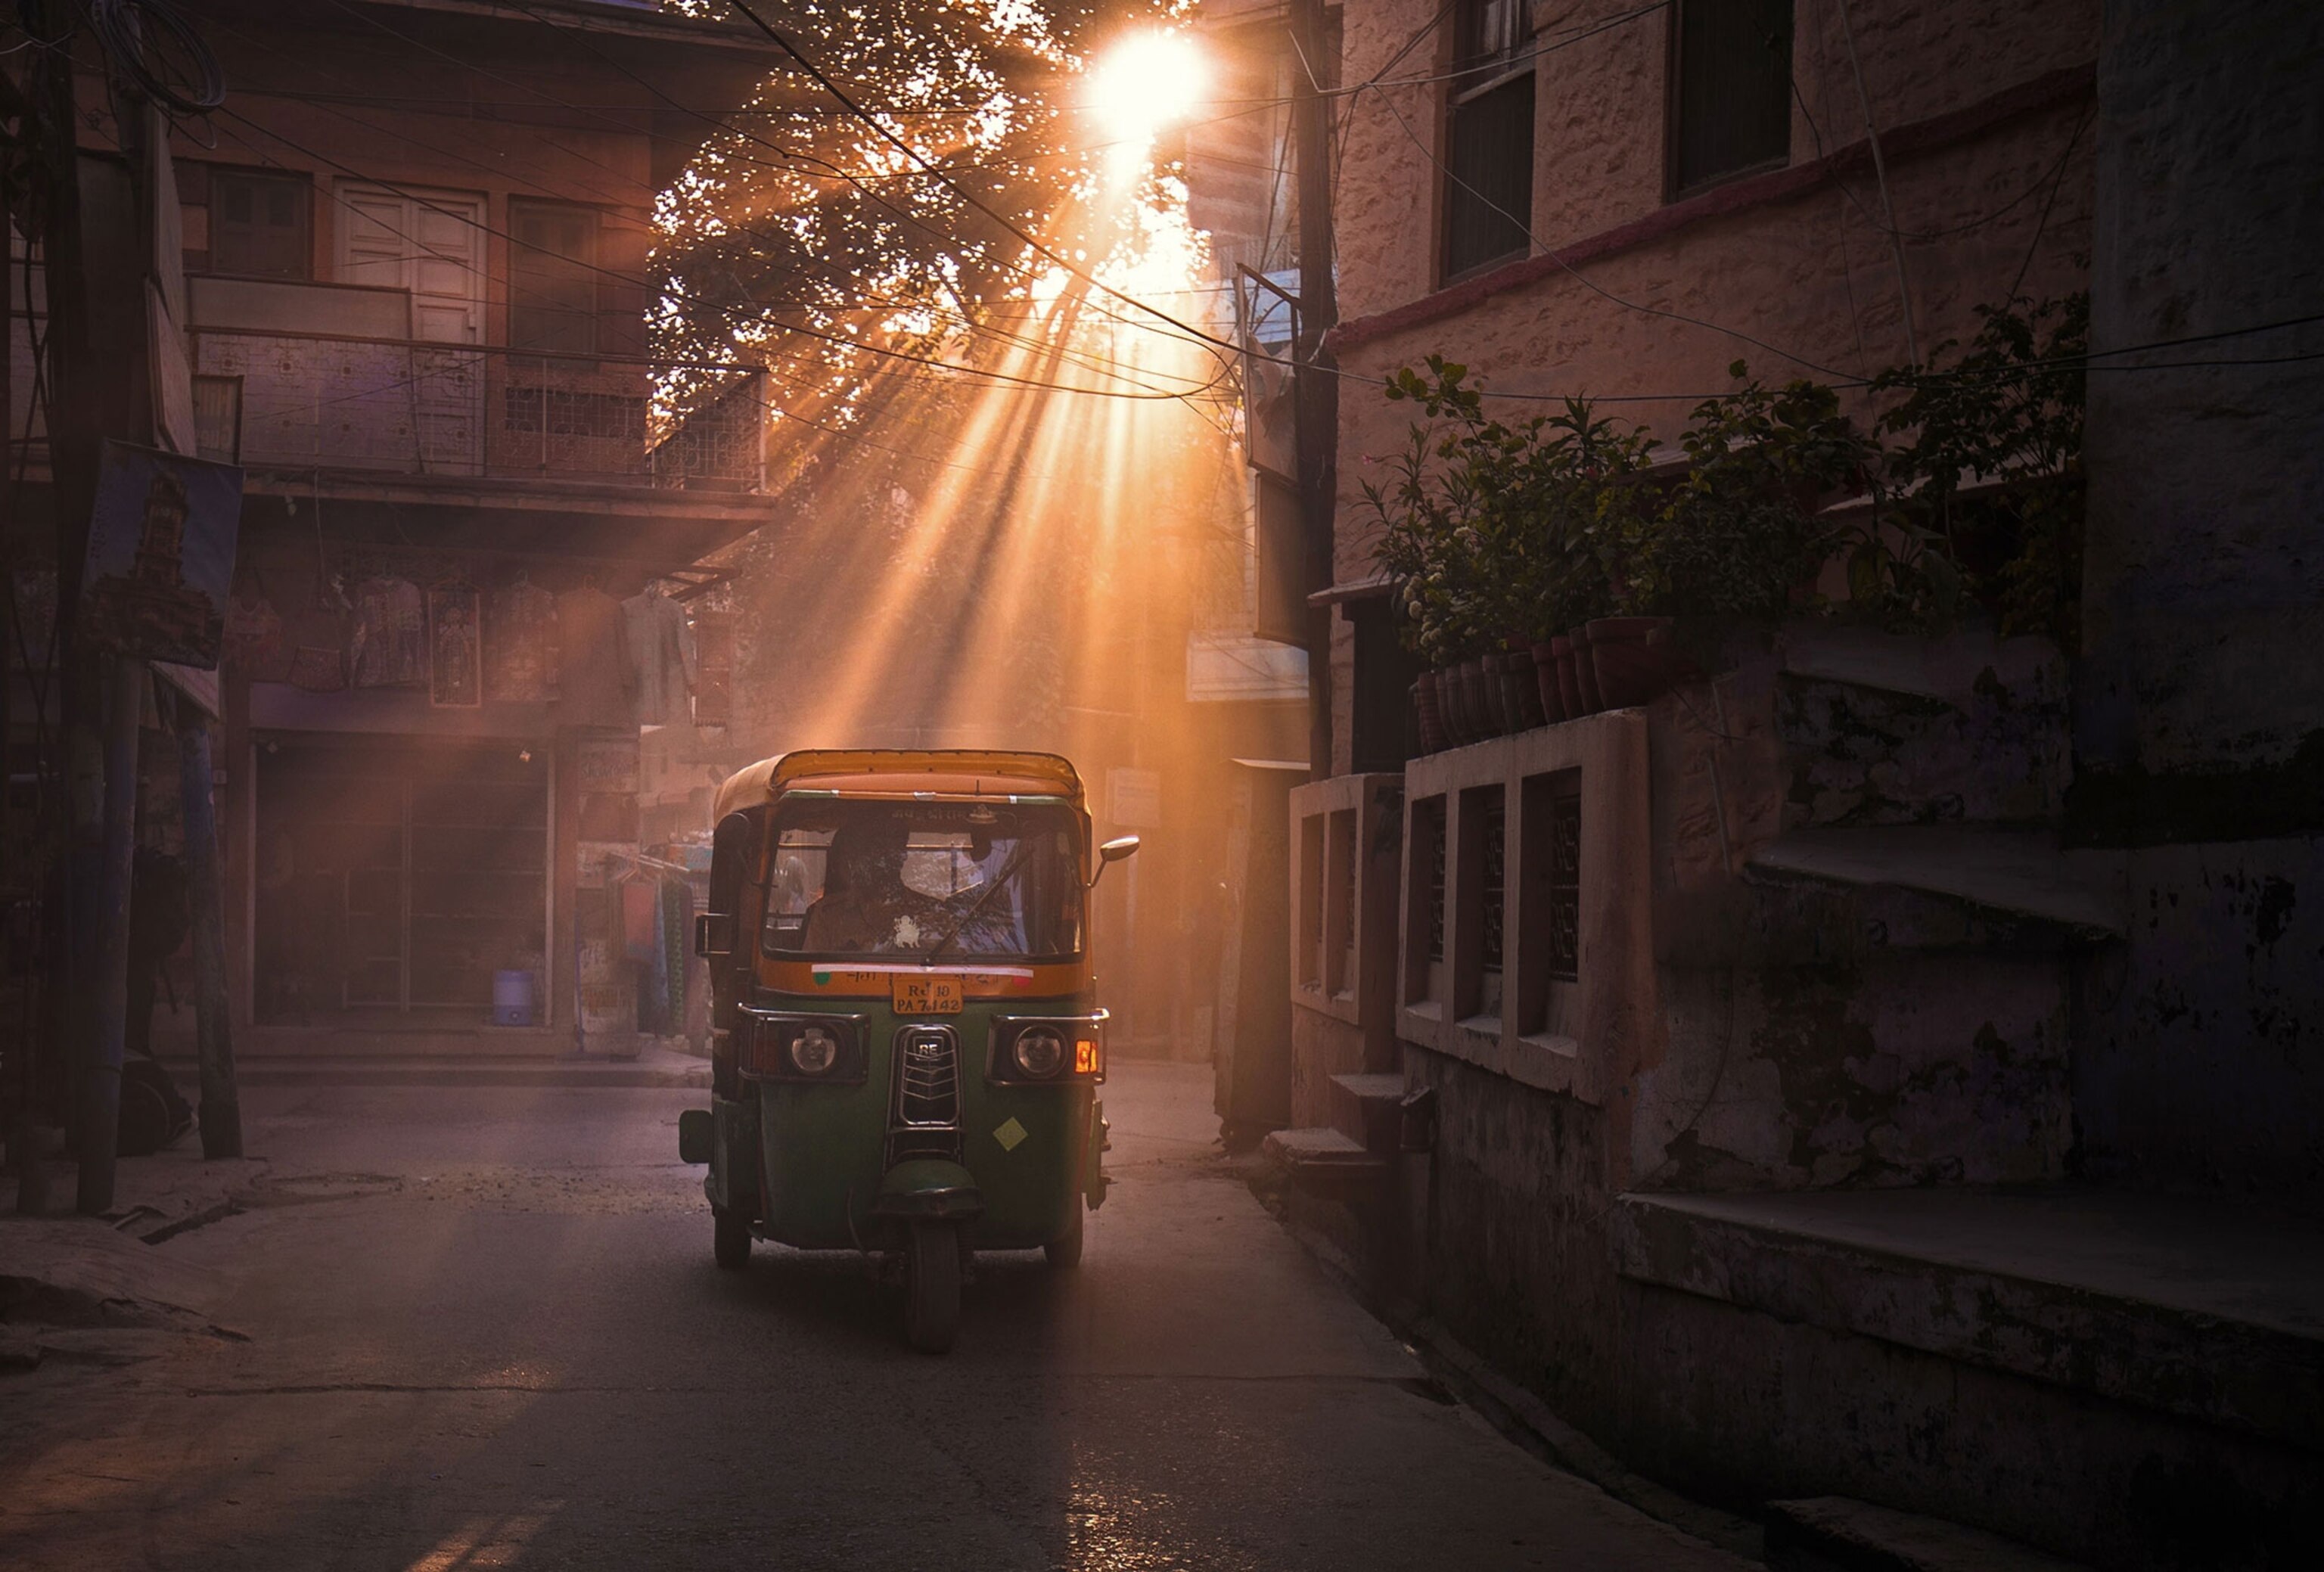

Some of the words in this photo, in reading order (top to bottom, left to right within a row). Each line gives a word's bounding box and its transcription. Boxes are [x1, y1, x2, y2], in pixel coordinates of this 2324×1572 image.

[908, 985, 929, 996] RJ
[896, 999, 914, 1011] PA
[918, 1043, 939, 1055] RE
